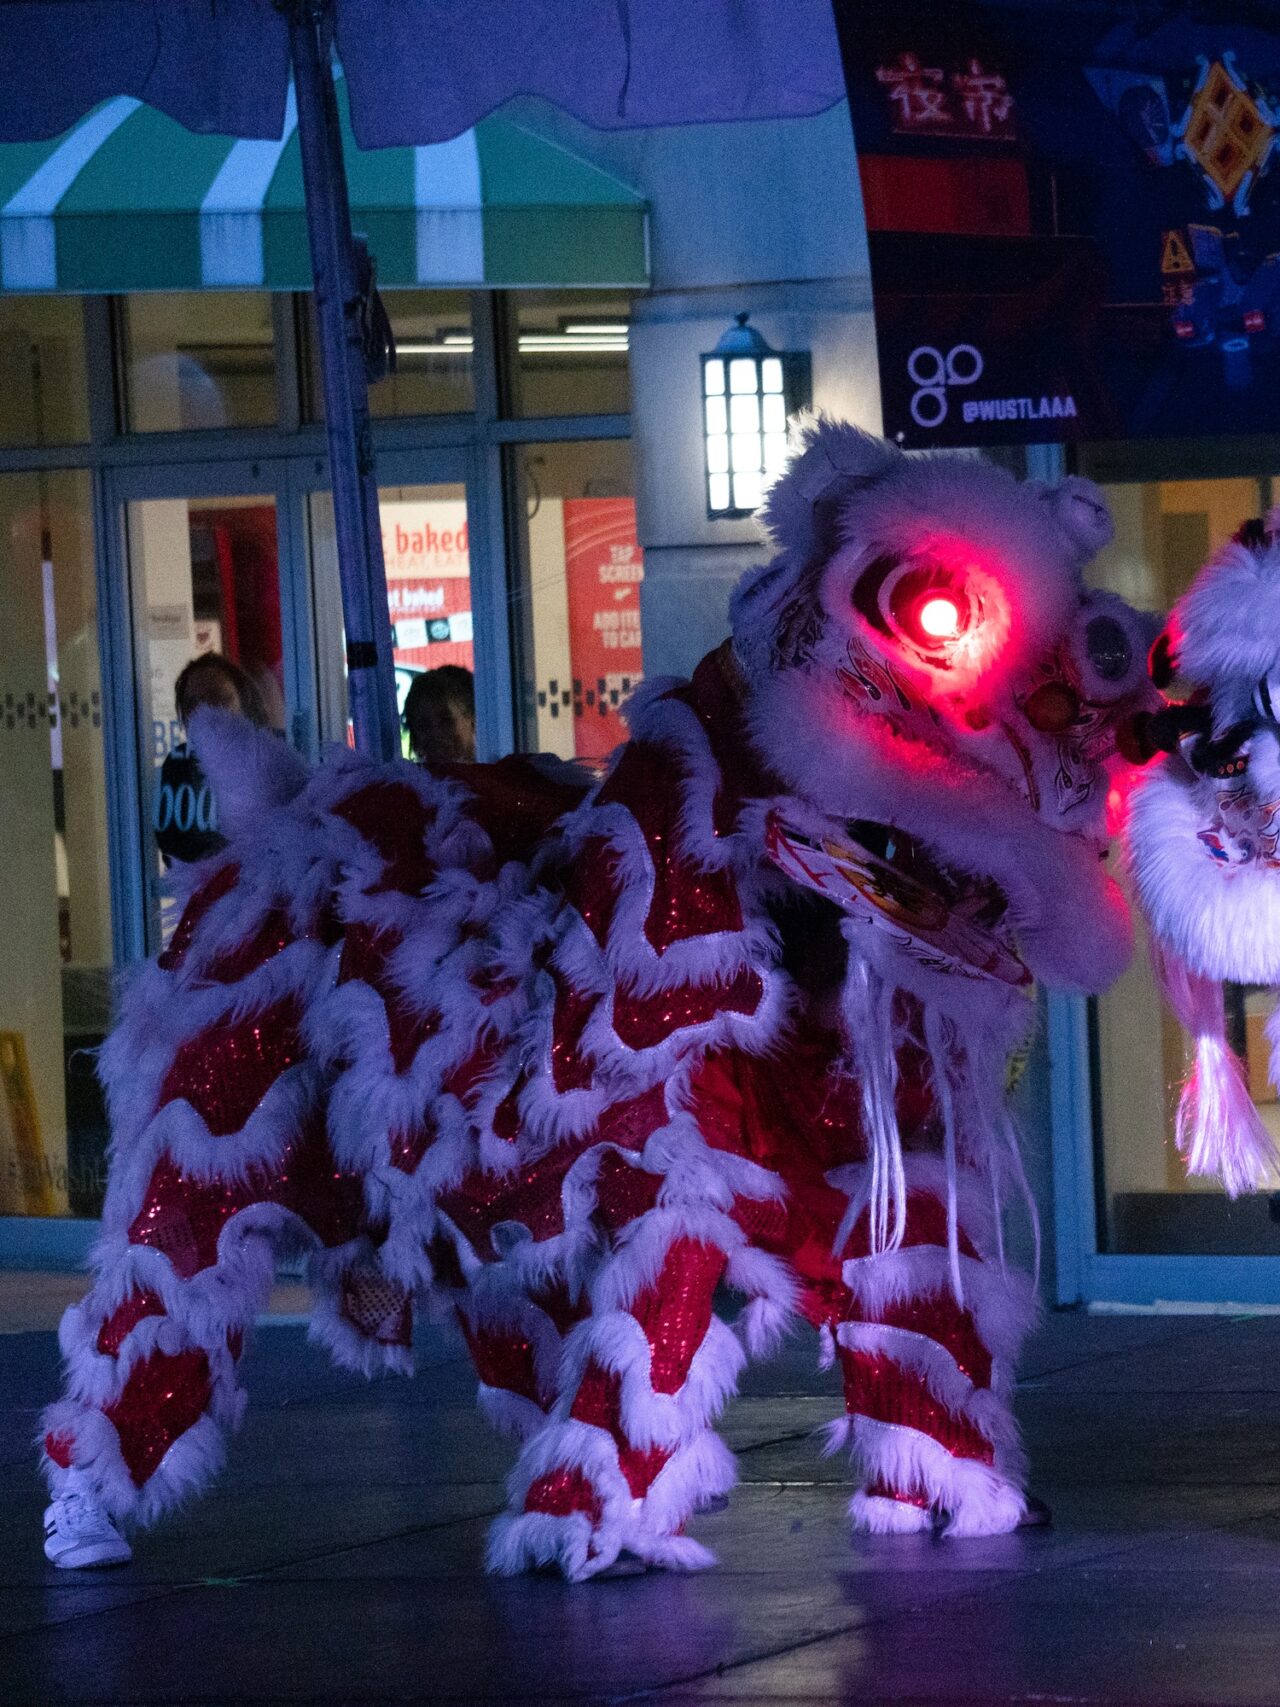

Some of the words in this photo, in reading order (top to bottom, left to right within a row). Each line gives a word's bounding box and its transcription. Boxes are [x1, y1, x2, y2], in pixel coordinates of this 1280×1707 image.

[963, 396, 1077, 423] @WUSTLAAA
[396, 521, 468, 555] baked
[621, 610, 640, 630] ITE
[151, 720, 191, 758] BE
